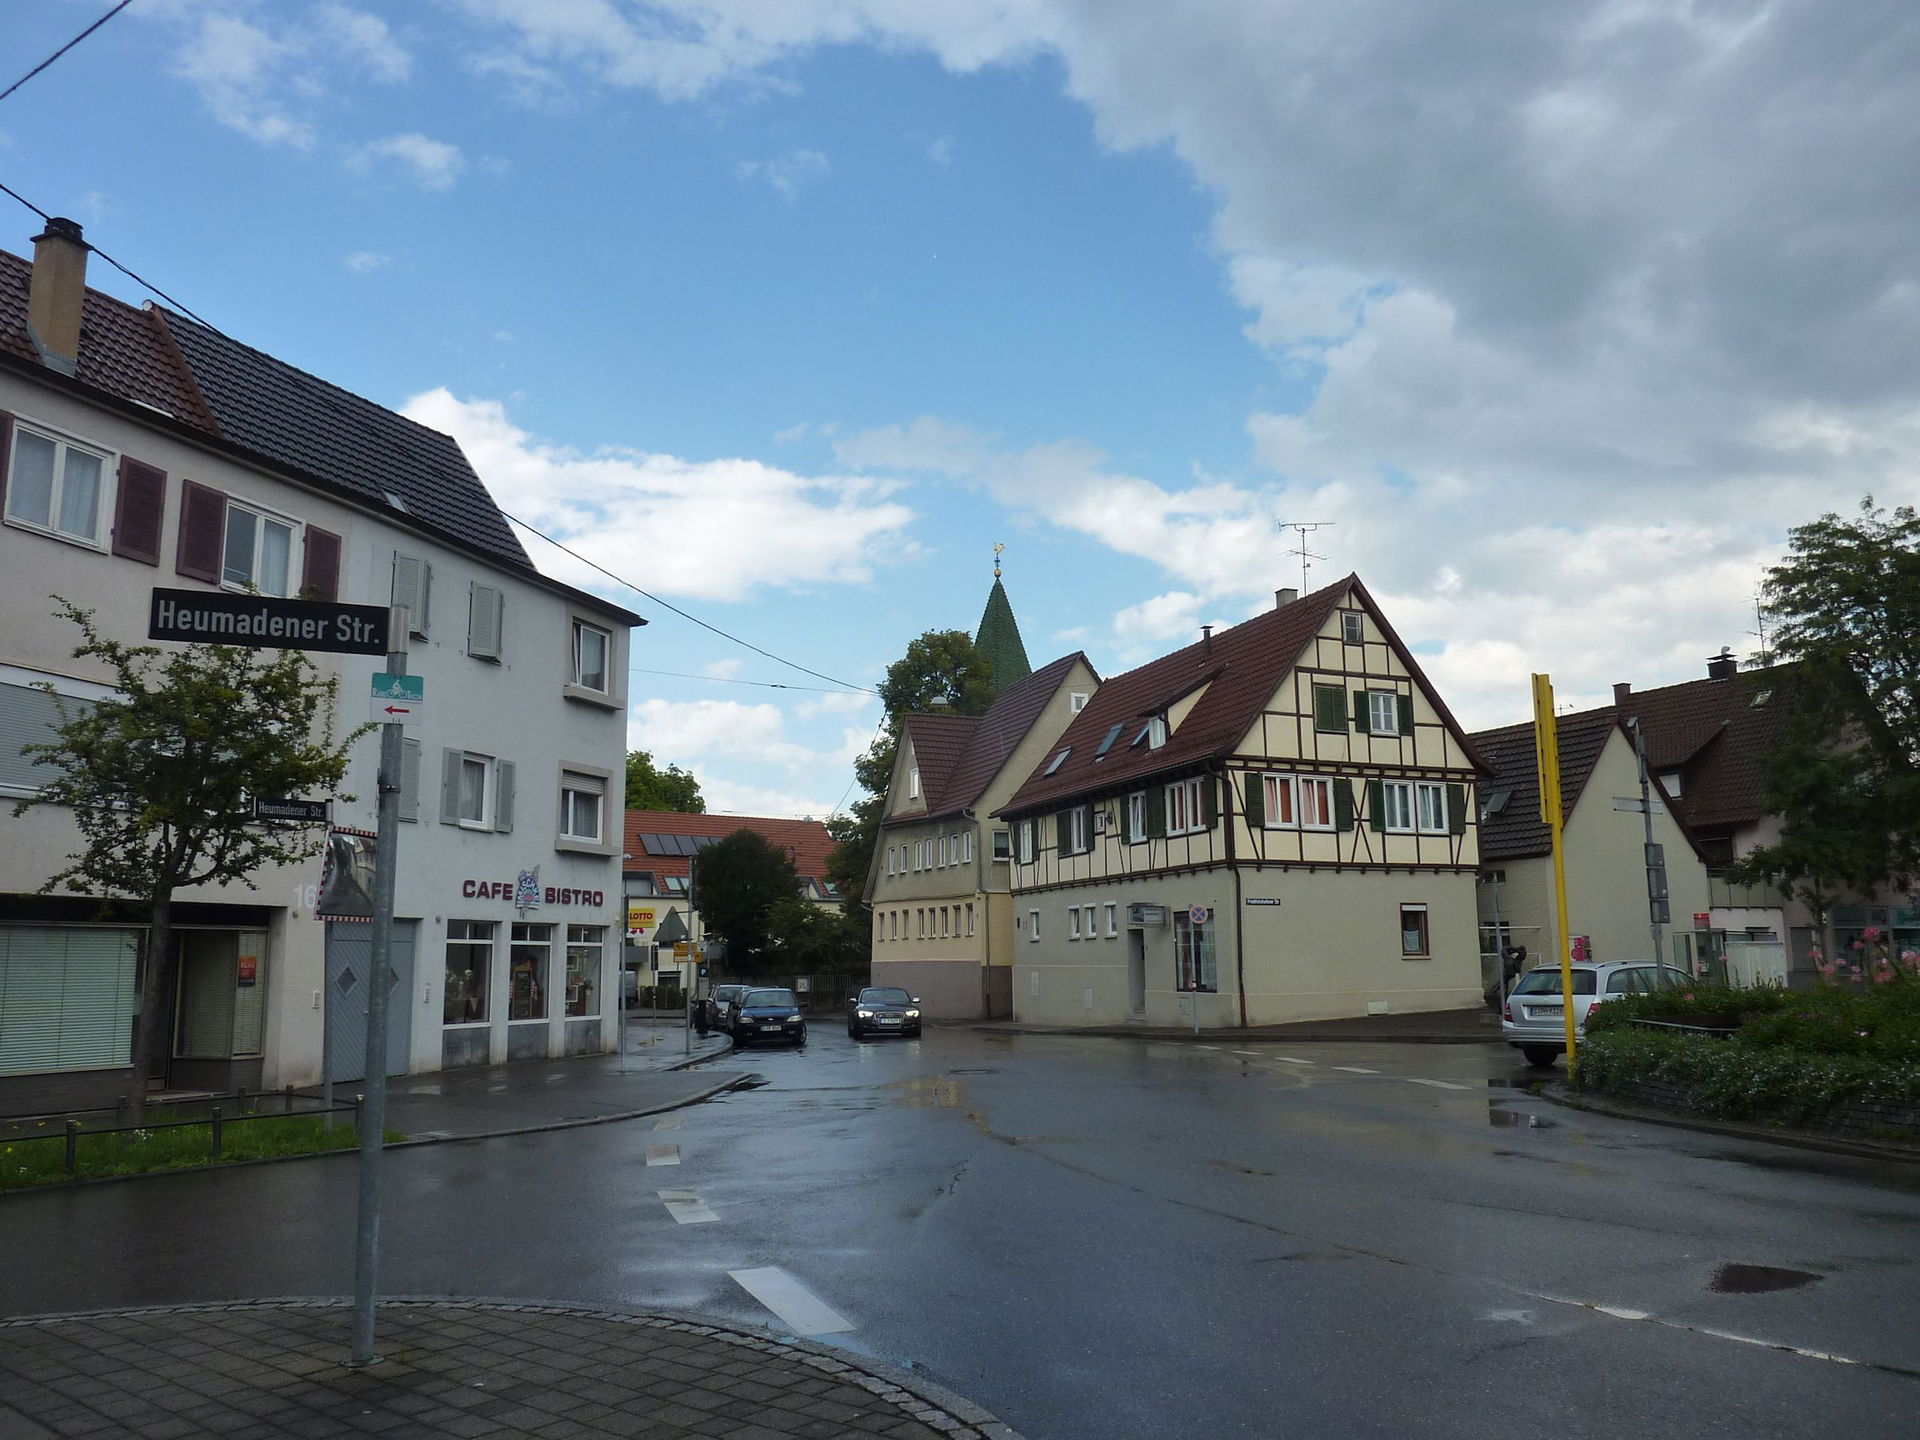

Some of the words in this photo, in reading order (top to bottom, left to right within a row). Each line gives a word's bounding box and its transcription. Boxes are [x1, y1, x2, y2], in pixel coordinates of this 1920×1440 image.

[157, 600, 329, 640] Heumadener
[335, 614, 380, 644] Str.
[258, 801, 307, 817] Heumadener
[310, 804, 324, 818] Str.
[292, 884, 317, 909] 16
[463, 879, 514, 901] CAFE
[545, 887, 604, 907] BISTRO
[629, 912, 653, 920] LOTTO
